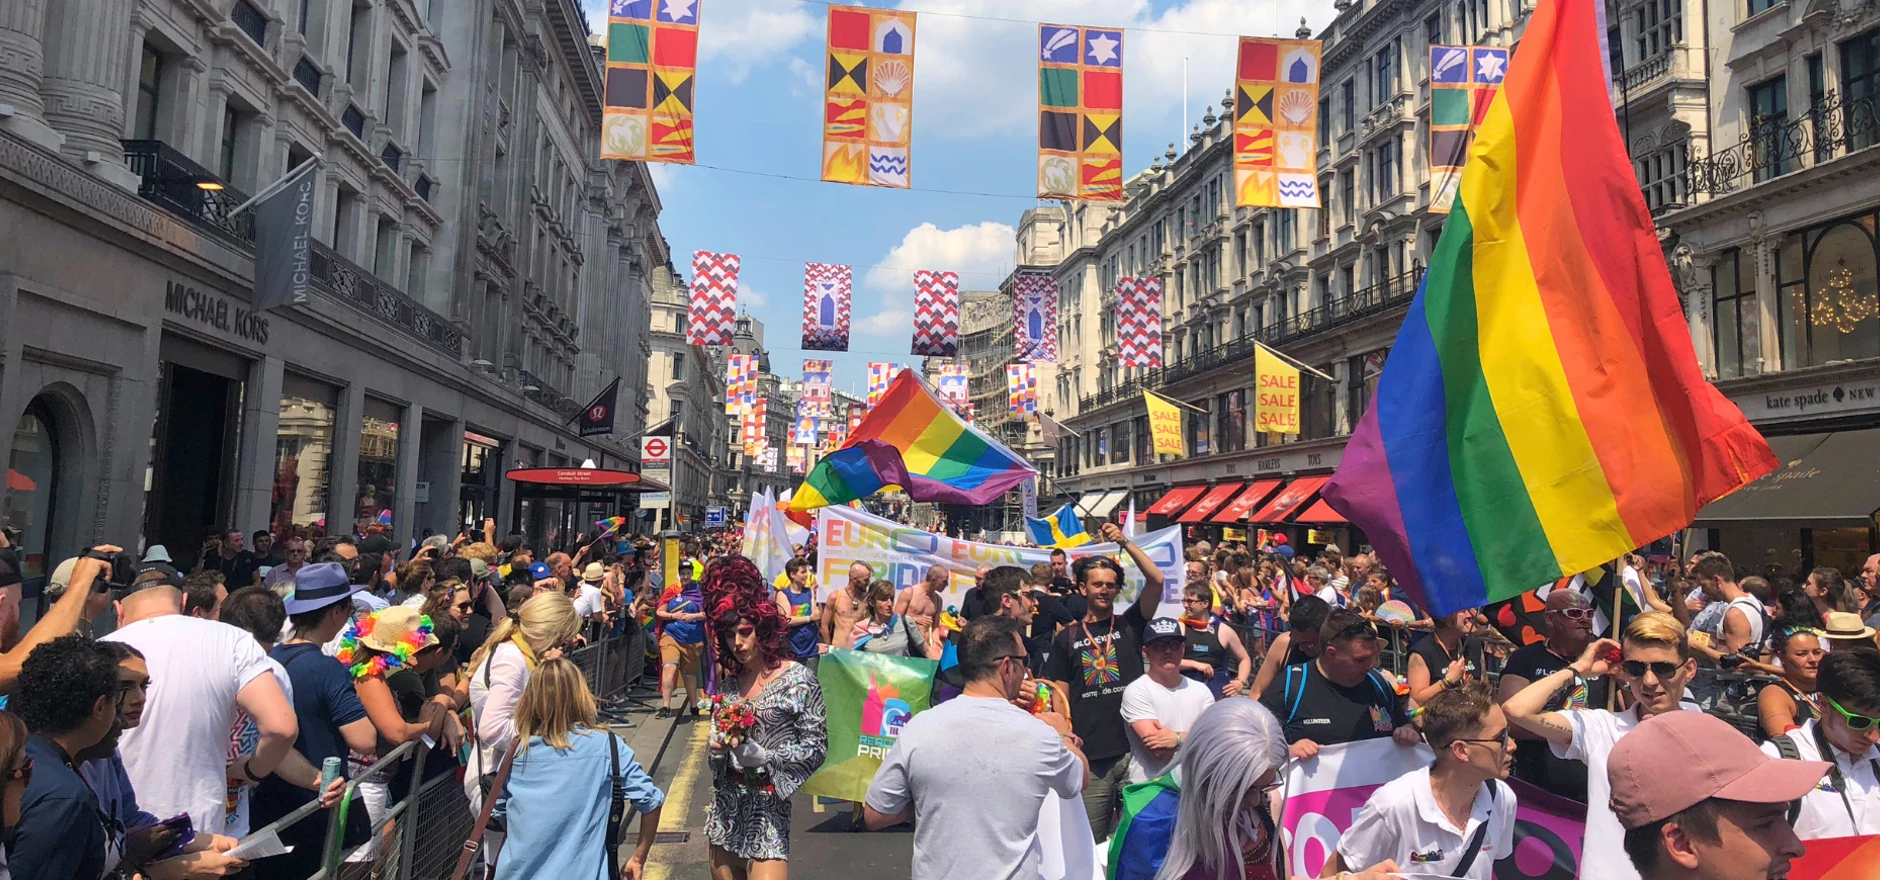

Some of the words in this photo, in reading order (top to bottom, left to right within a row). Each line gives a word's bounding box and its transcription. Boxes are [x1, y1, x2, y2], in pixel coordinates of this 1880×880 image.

[293, 231, 309, 303] MICHAEL
[164, 280, 231, 332] MICHAEL
[234, 307, 270, 346] KORS
[1260, 374, 1296, 389] SALE
[1260, 393, 1296, 408] SALE
[1765, 395, 1791, 410] kate
[1793, 389, 1829, 411] spade
[1848, 387, 1875, 400] NEW
[1152, 410, 1179, 421] SALE
[1259, 411, 1296, 426] SALE
[582, 426, 611, 434] lululemon
[1154, 424, 1181, 435] SALE
[1156, 438, 1182, 450] SALE
[1226, 464, 1236, 474] TOYS
[1258, 458, 1280, 471] HAMLEYS
[1307, 454, 1322, 467] TOYS
[825, 518, 938, 555] EURO
[1073, 630, 1121, 650] #LOEWNS
